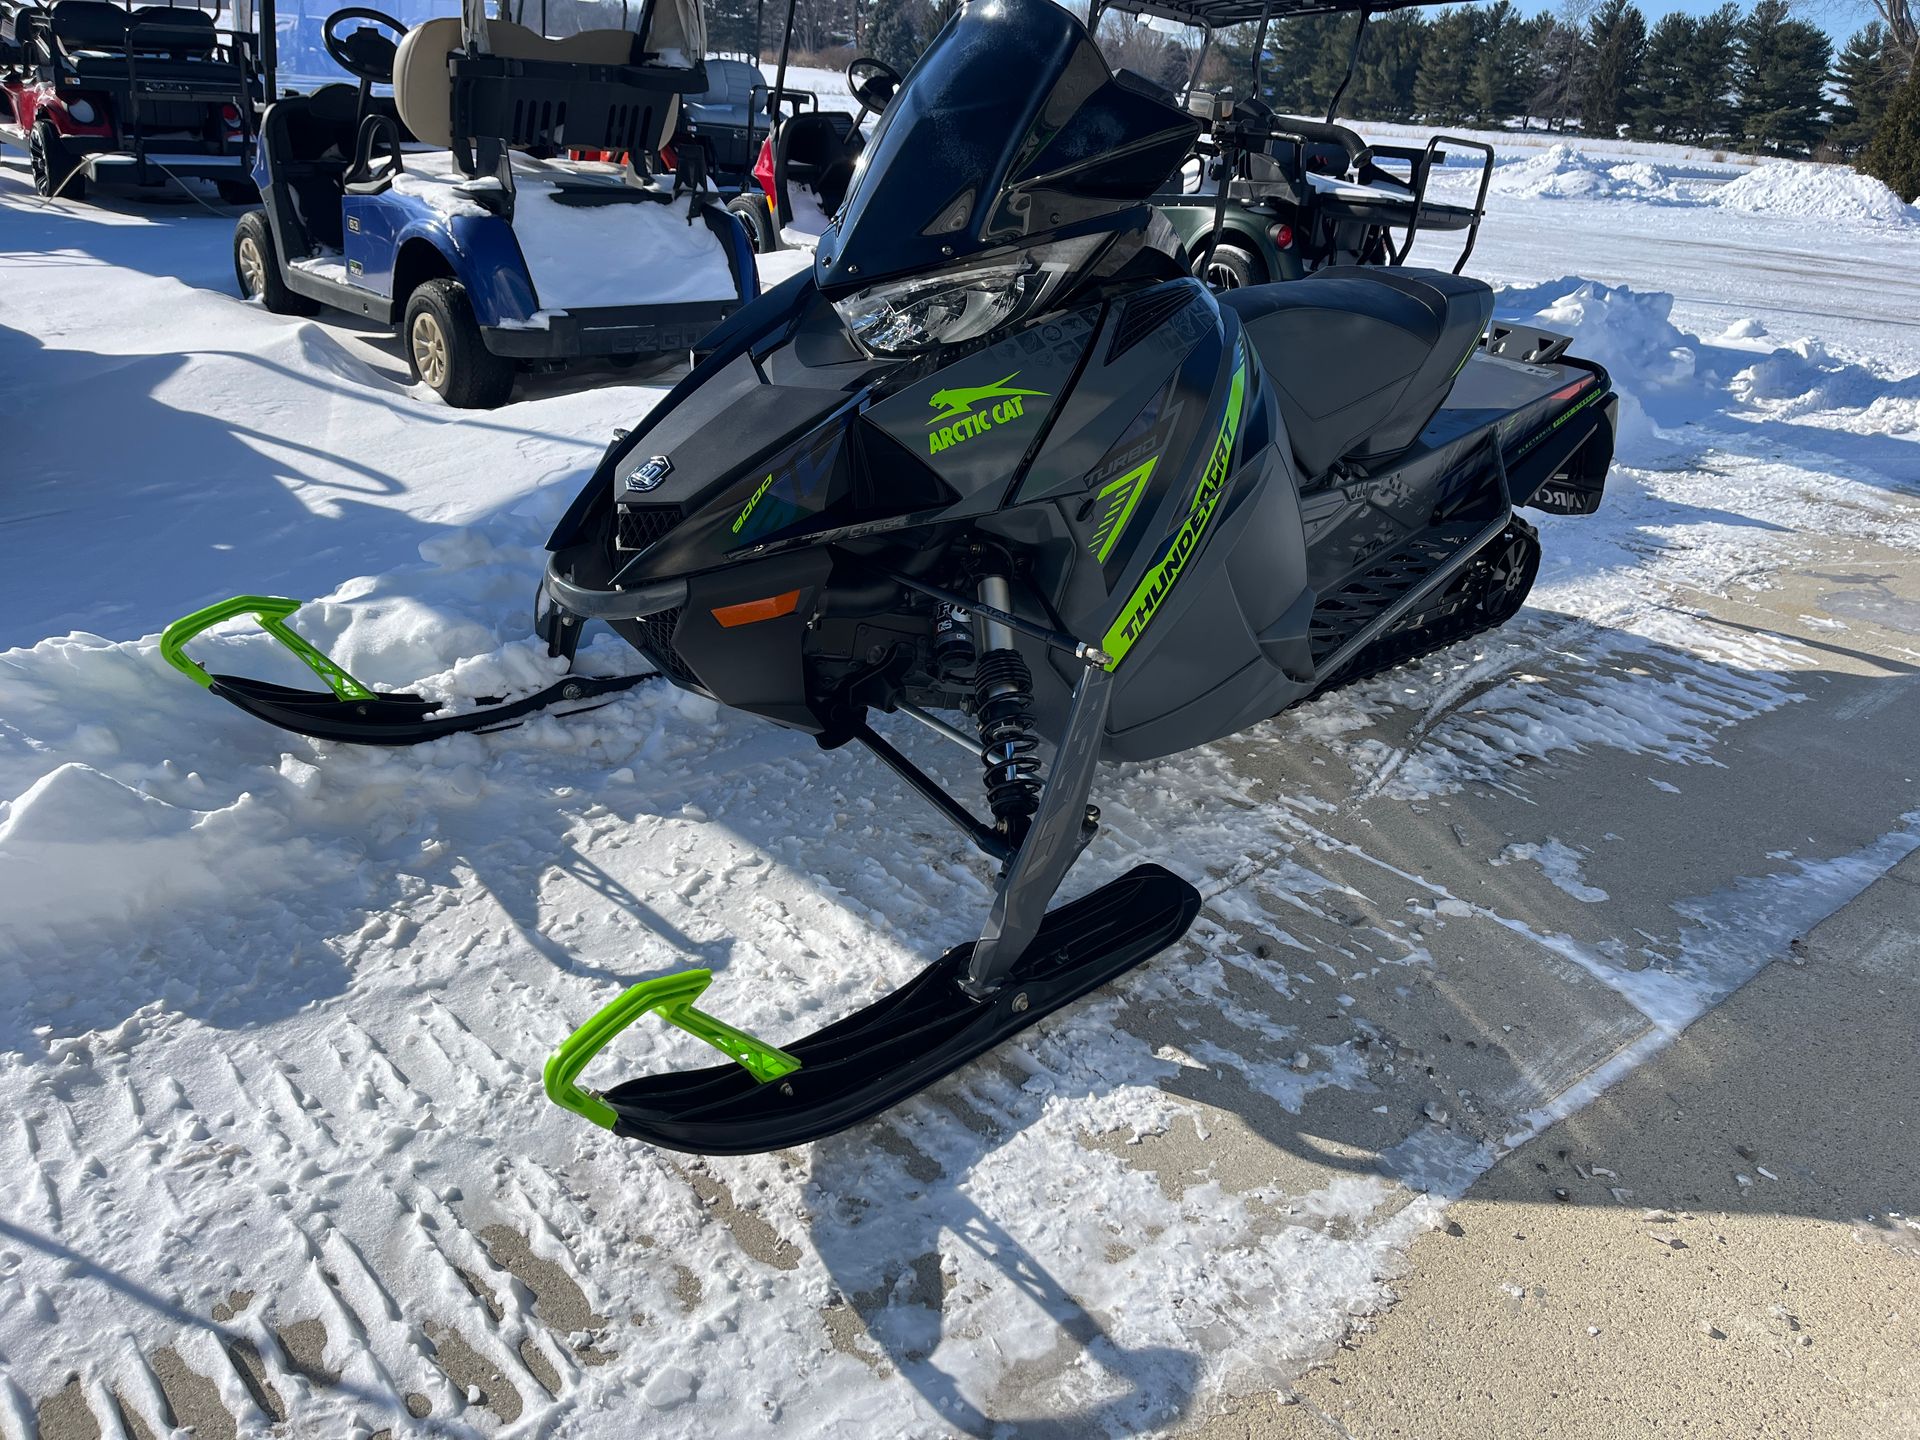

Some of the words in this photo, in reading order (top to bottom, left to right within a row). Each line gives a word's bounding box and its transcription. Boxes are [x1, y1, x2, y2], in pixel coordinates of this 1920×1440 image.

[928, 410, 992, 455] ARCTIC
[992, 396, 1025, 424] CAT
[1084, 435, 1162, 487] TURBO
[732, 473, 772, 533] 9000
[1120, 416, 1233, 640] THUNDERCAT
